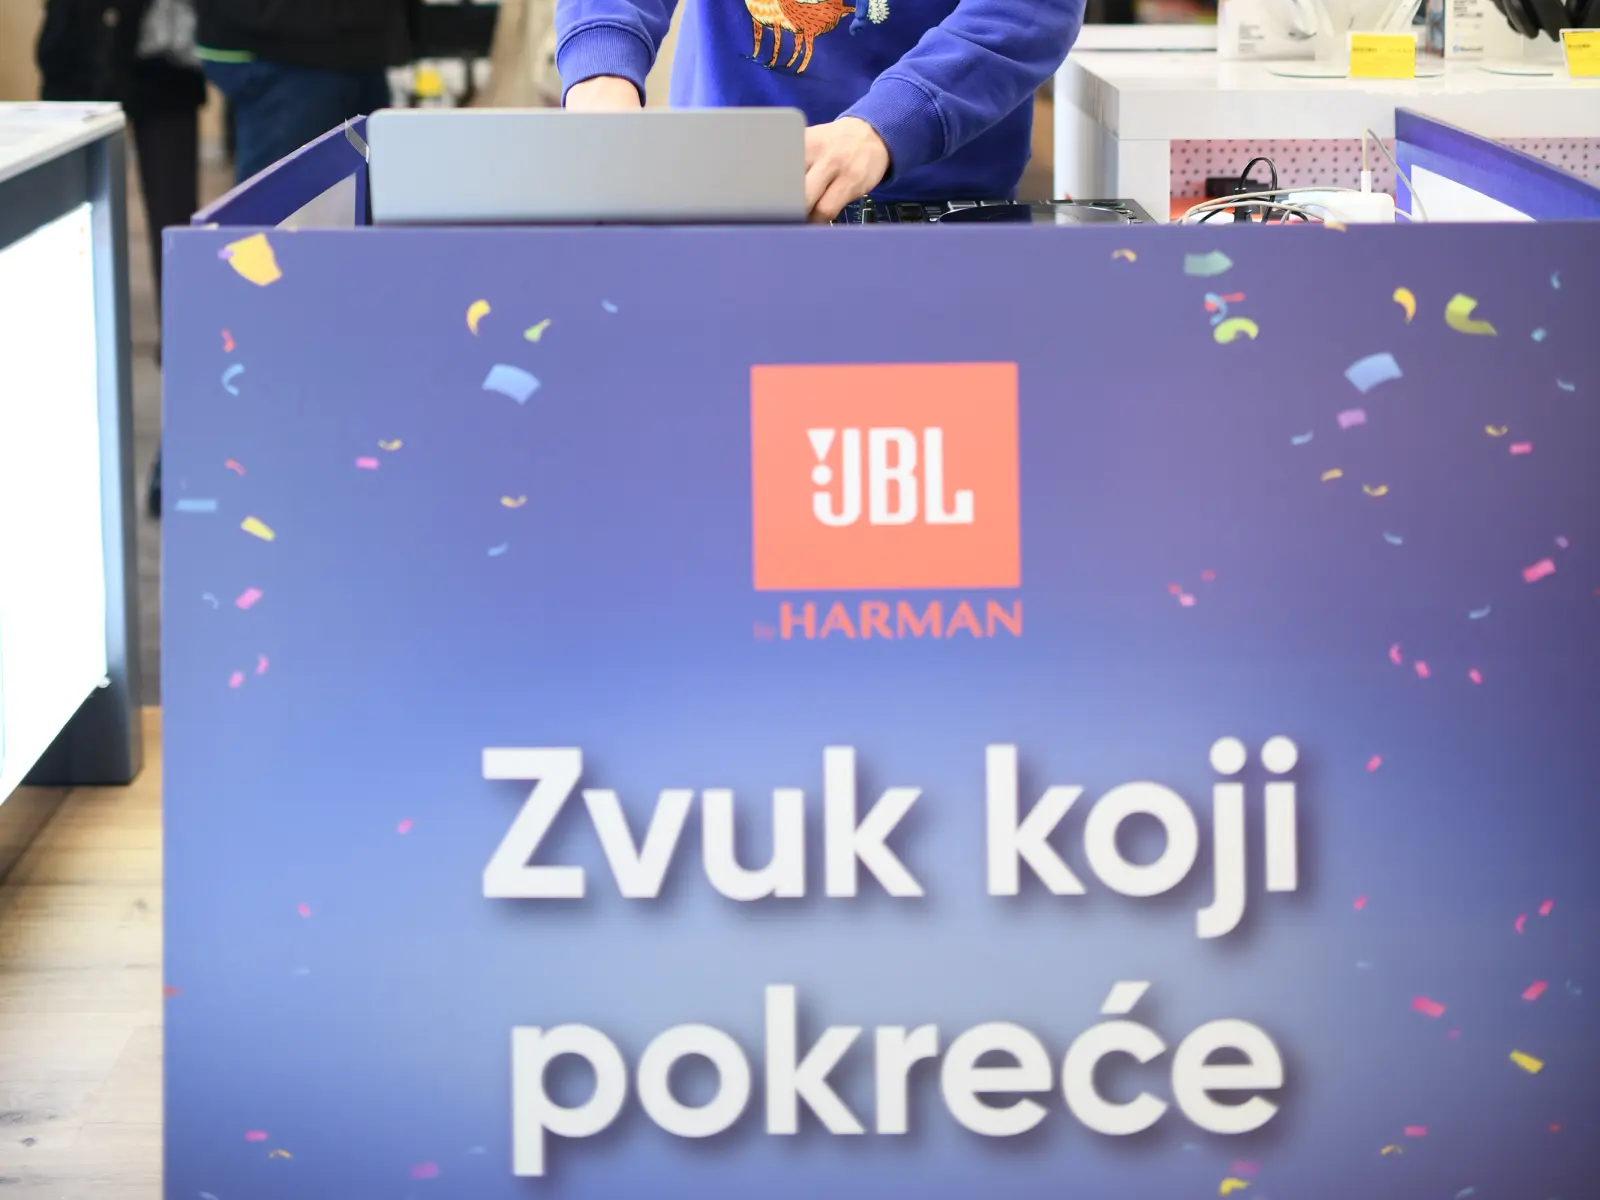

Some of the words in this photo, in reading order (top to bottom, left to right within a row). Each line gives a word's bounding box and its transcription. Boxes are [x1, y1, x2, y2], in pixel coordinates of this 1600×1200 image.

[806, 426, 975, 527] JBL
[779, 599, 1023, 641] HARMAN
[481, 746, 925, 902] Zvuk
[986, 736, 1300, 939] koji
[511, 981, 1284, 1178] pokreće
